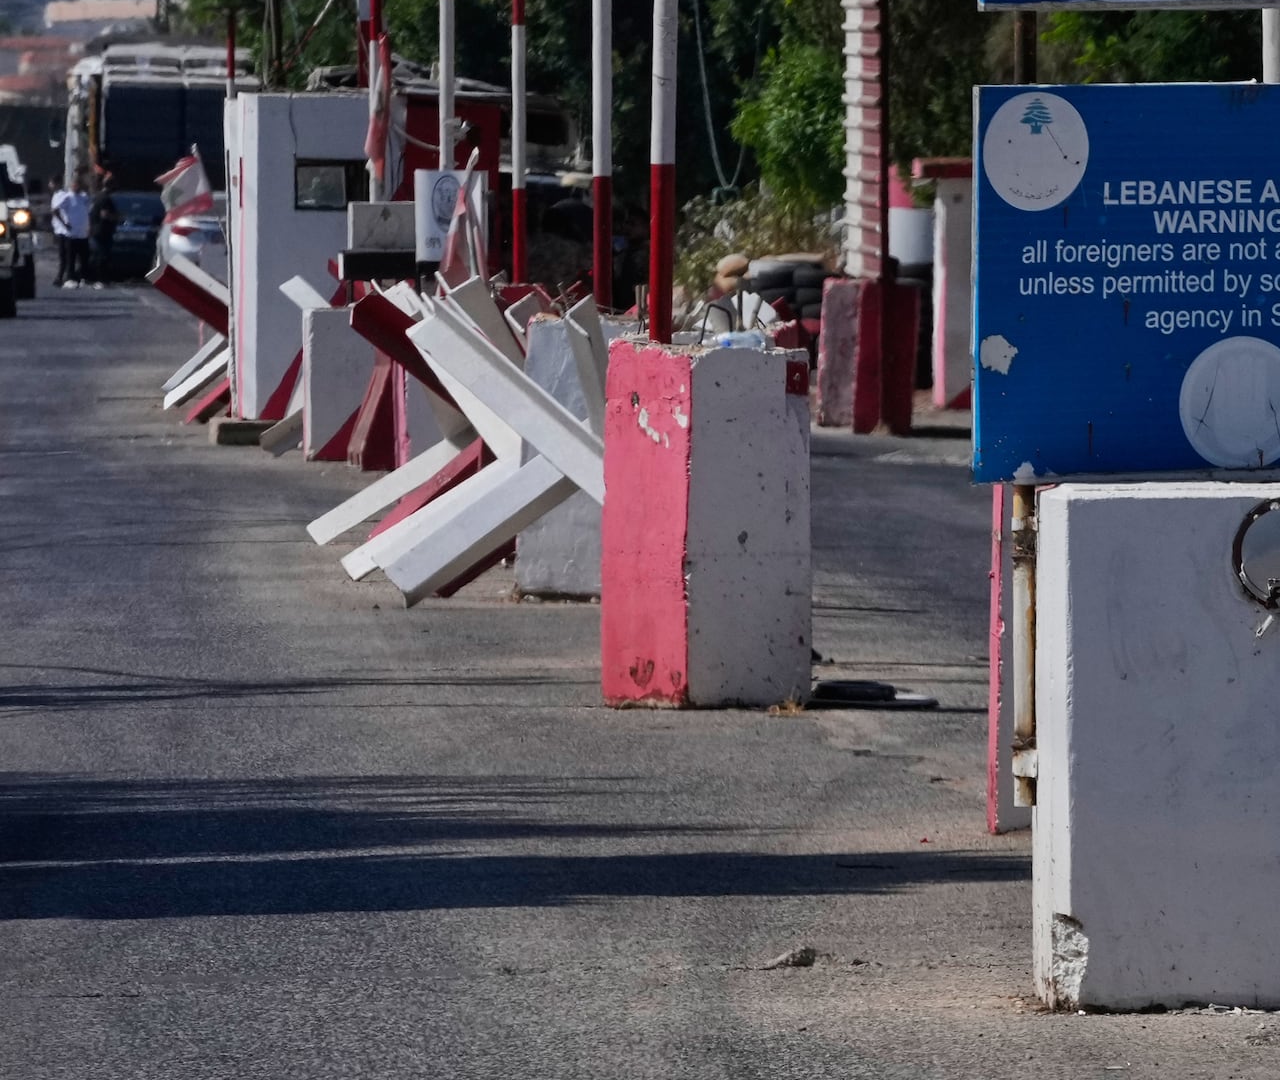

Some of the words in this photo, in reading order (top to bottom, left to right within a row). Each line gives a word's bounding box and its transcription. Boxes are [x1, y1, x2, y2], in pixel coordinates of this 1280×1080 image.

[1103, 181, 1252, 206] LEBANESE
[1022, 241, 1048, 264] all
[1056, 241, 1174, 268] foreigners
[1182, 243, 1221, 261] are
[1229, 242, 1268, 260] not
[1019, 271, 1095, 295] unless
[1102, 269, 1215, 299] permitted
[1223, 269, 1252, 297] by
[1145, 310, 1233, 334] agency
[1241, 304, 1262, 327] in
